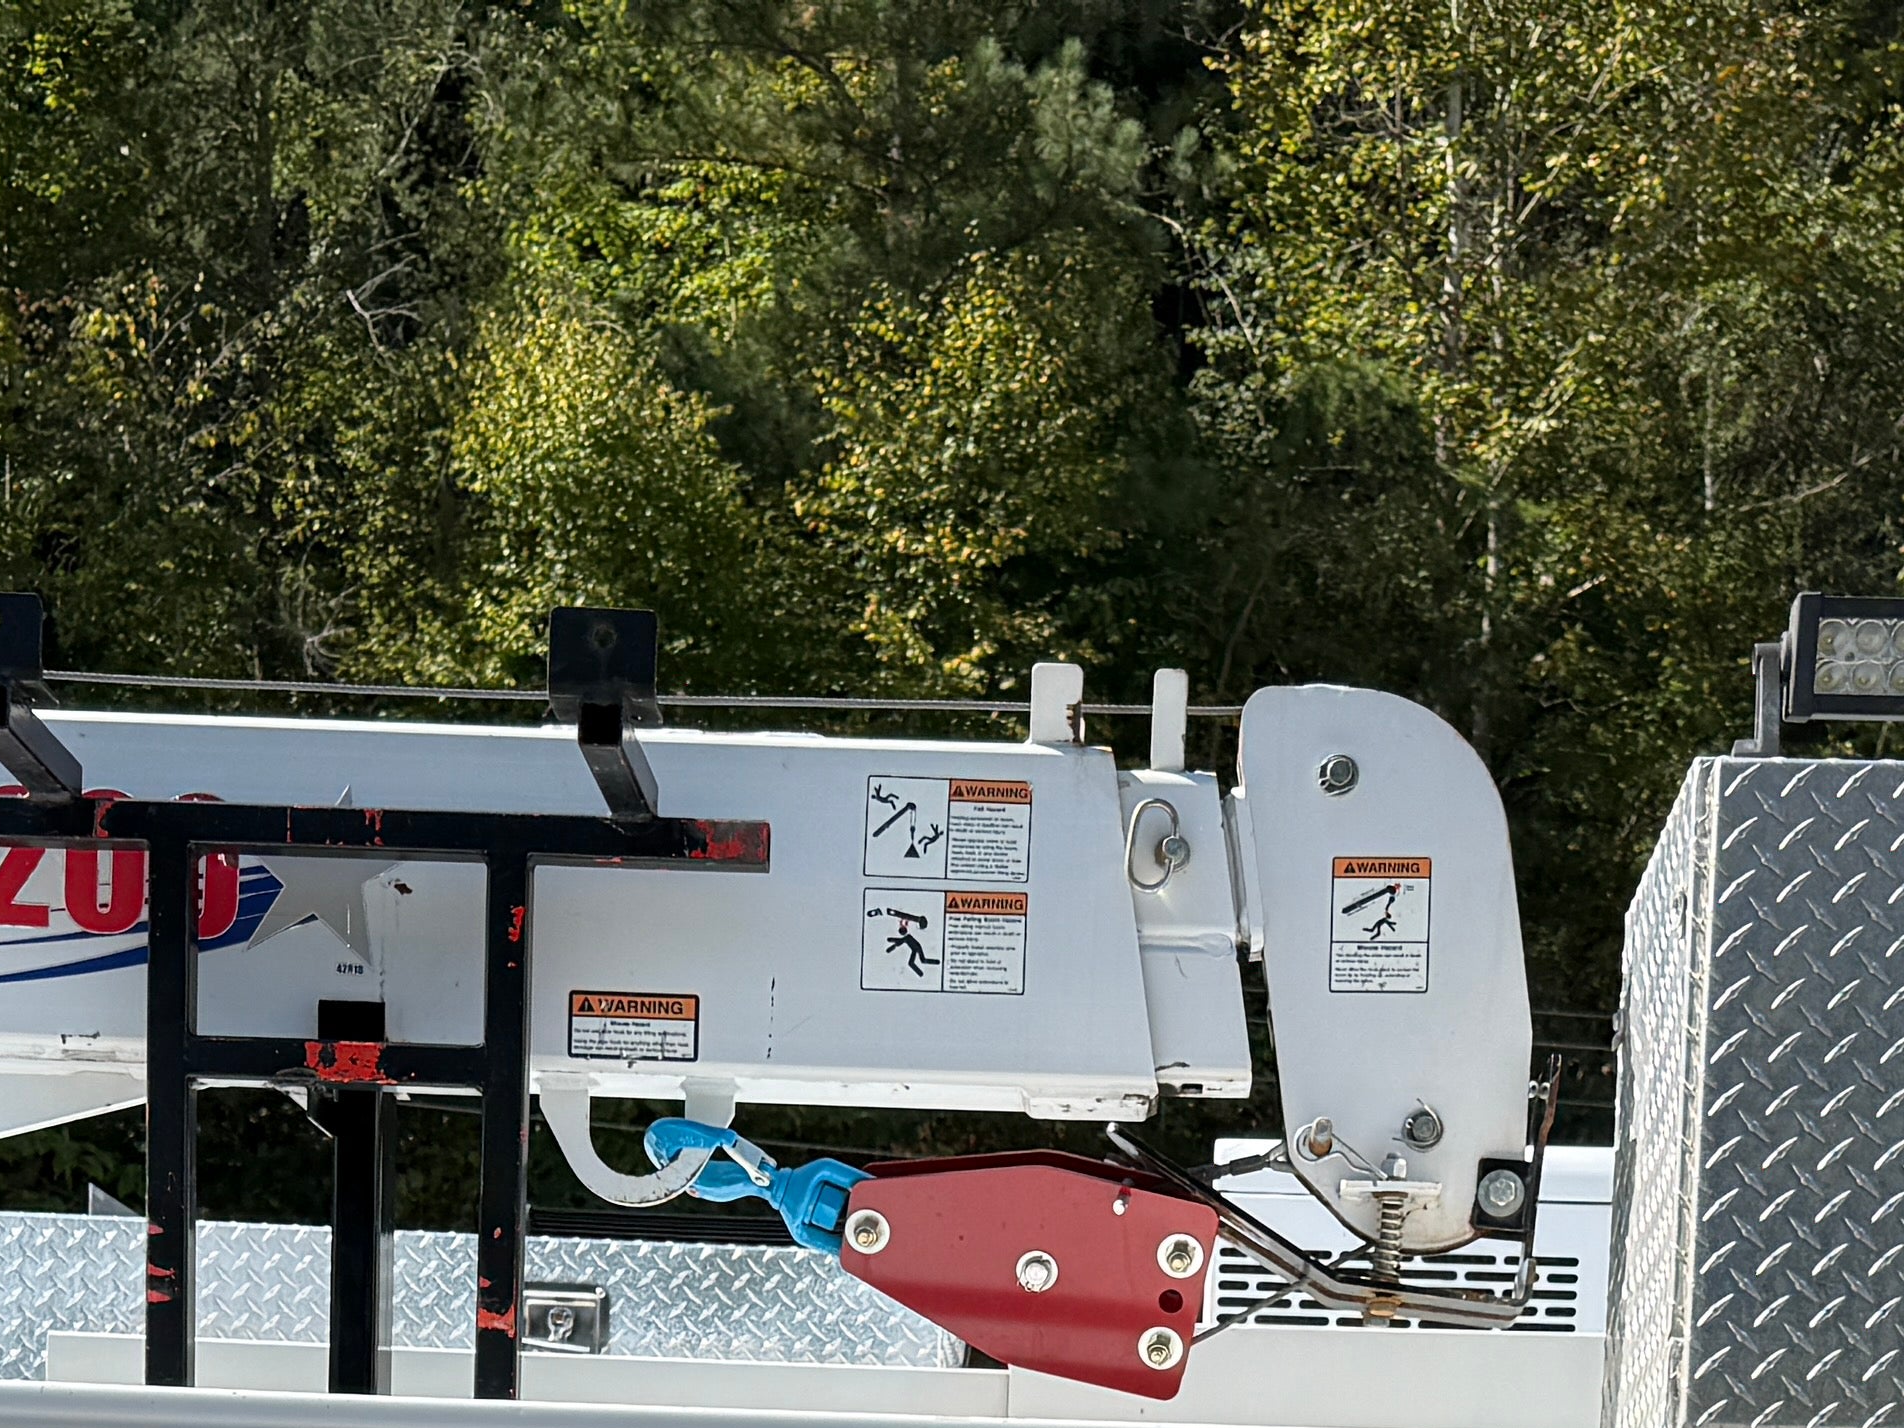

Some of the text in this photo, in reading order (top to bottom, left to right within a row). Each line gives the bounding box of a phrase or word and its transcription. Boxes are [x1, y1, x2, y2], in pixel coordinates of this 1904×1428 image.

[965, 786, 1028, 799] WARNING
[1356, 862, 1420, 873] WARNING
[960, 898, 1024, 910] WARNING
[598, 998, 684, 1015] WARNING
